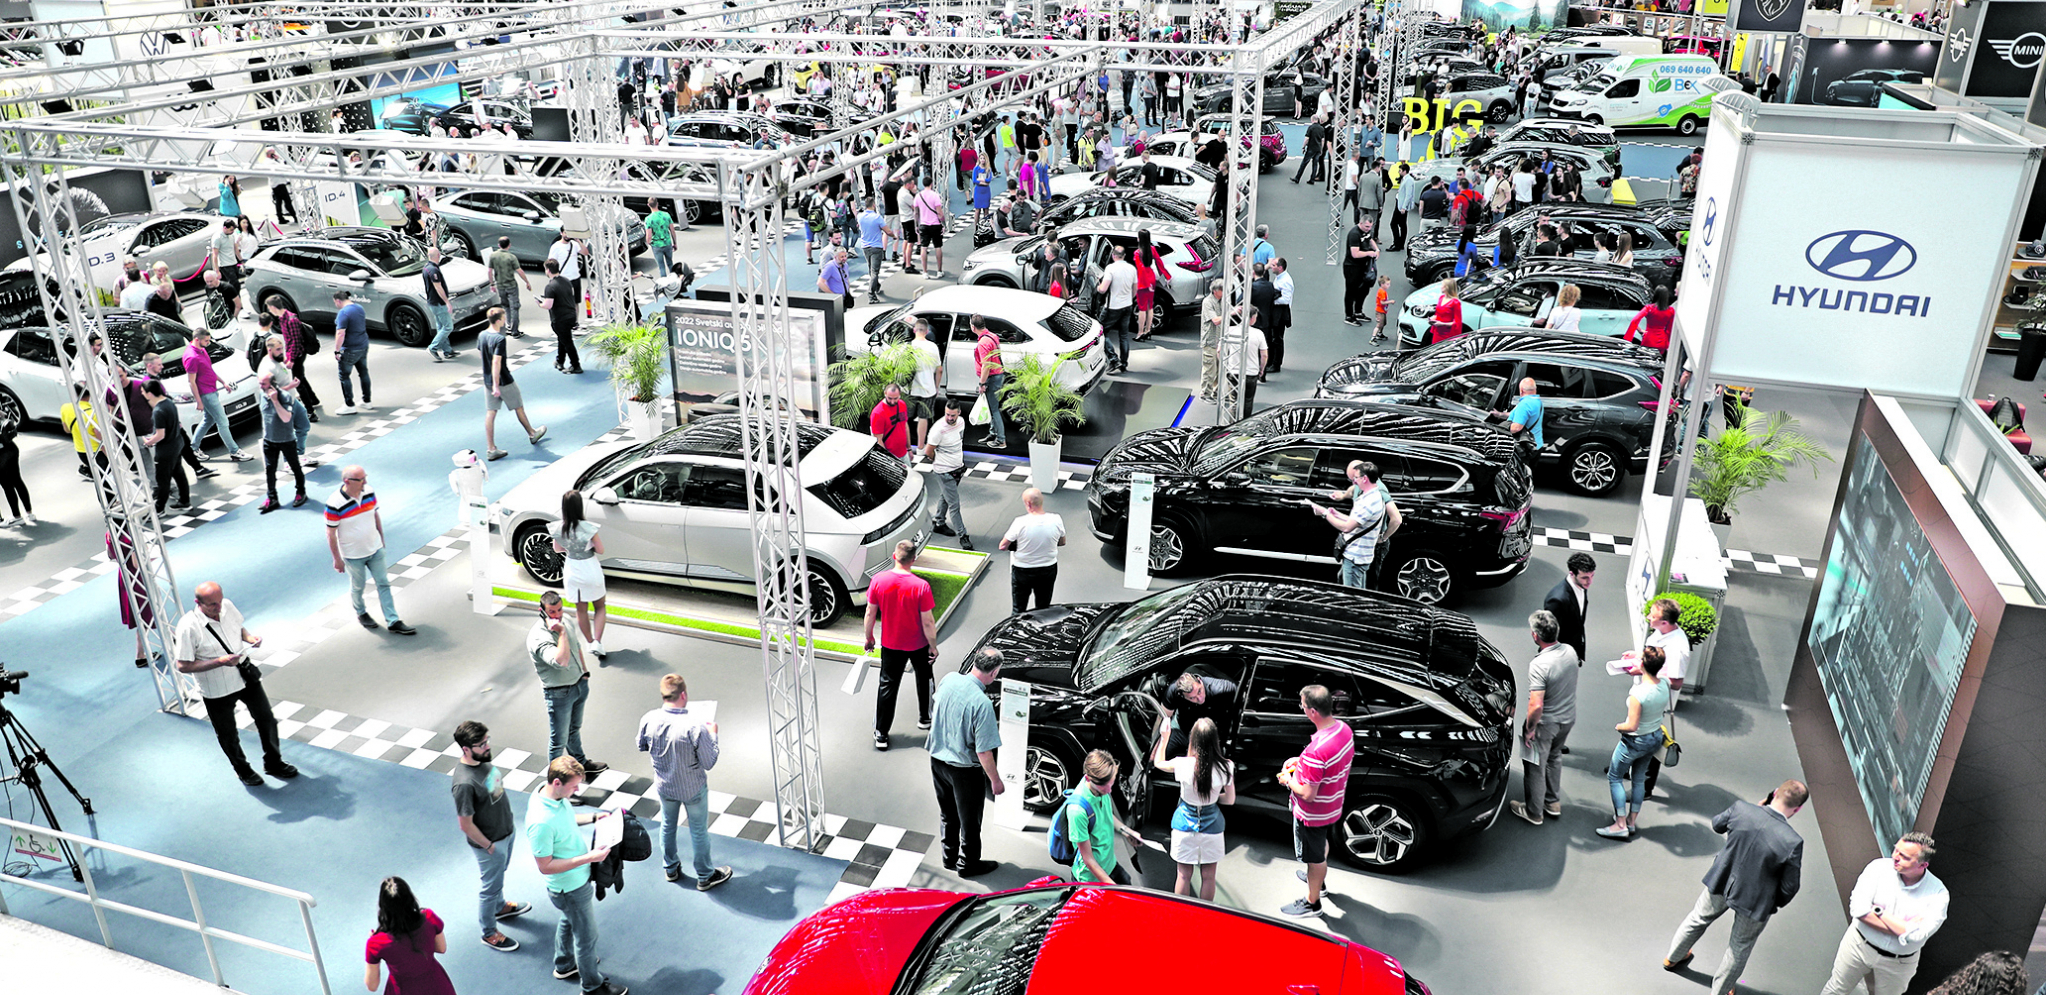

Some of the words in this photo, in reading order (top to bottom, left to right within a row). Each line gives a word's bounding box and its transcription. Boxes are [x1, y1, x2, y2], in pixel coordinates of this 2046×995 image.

[2014, 45, 2043, 55] MINI
[1660, 65, 1676, 73] 069
[1677, 66, 1694, 74] 640
[1695, 66, 1711, 74] 640
[1402, 97, 1484, 139] BIG
[325, 190, 346, 203] ID.4
[88, 252, 116, 267] D.3
[1771, 284, 1931, 317] HYUNDAI
[675, 316, 694, 325] 2022
[695, 318, 723, 328] Svetski
[676, 328, 736, 354] IONIQ
[740, 333, 752, 352] 5
